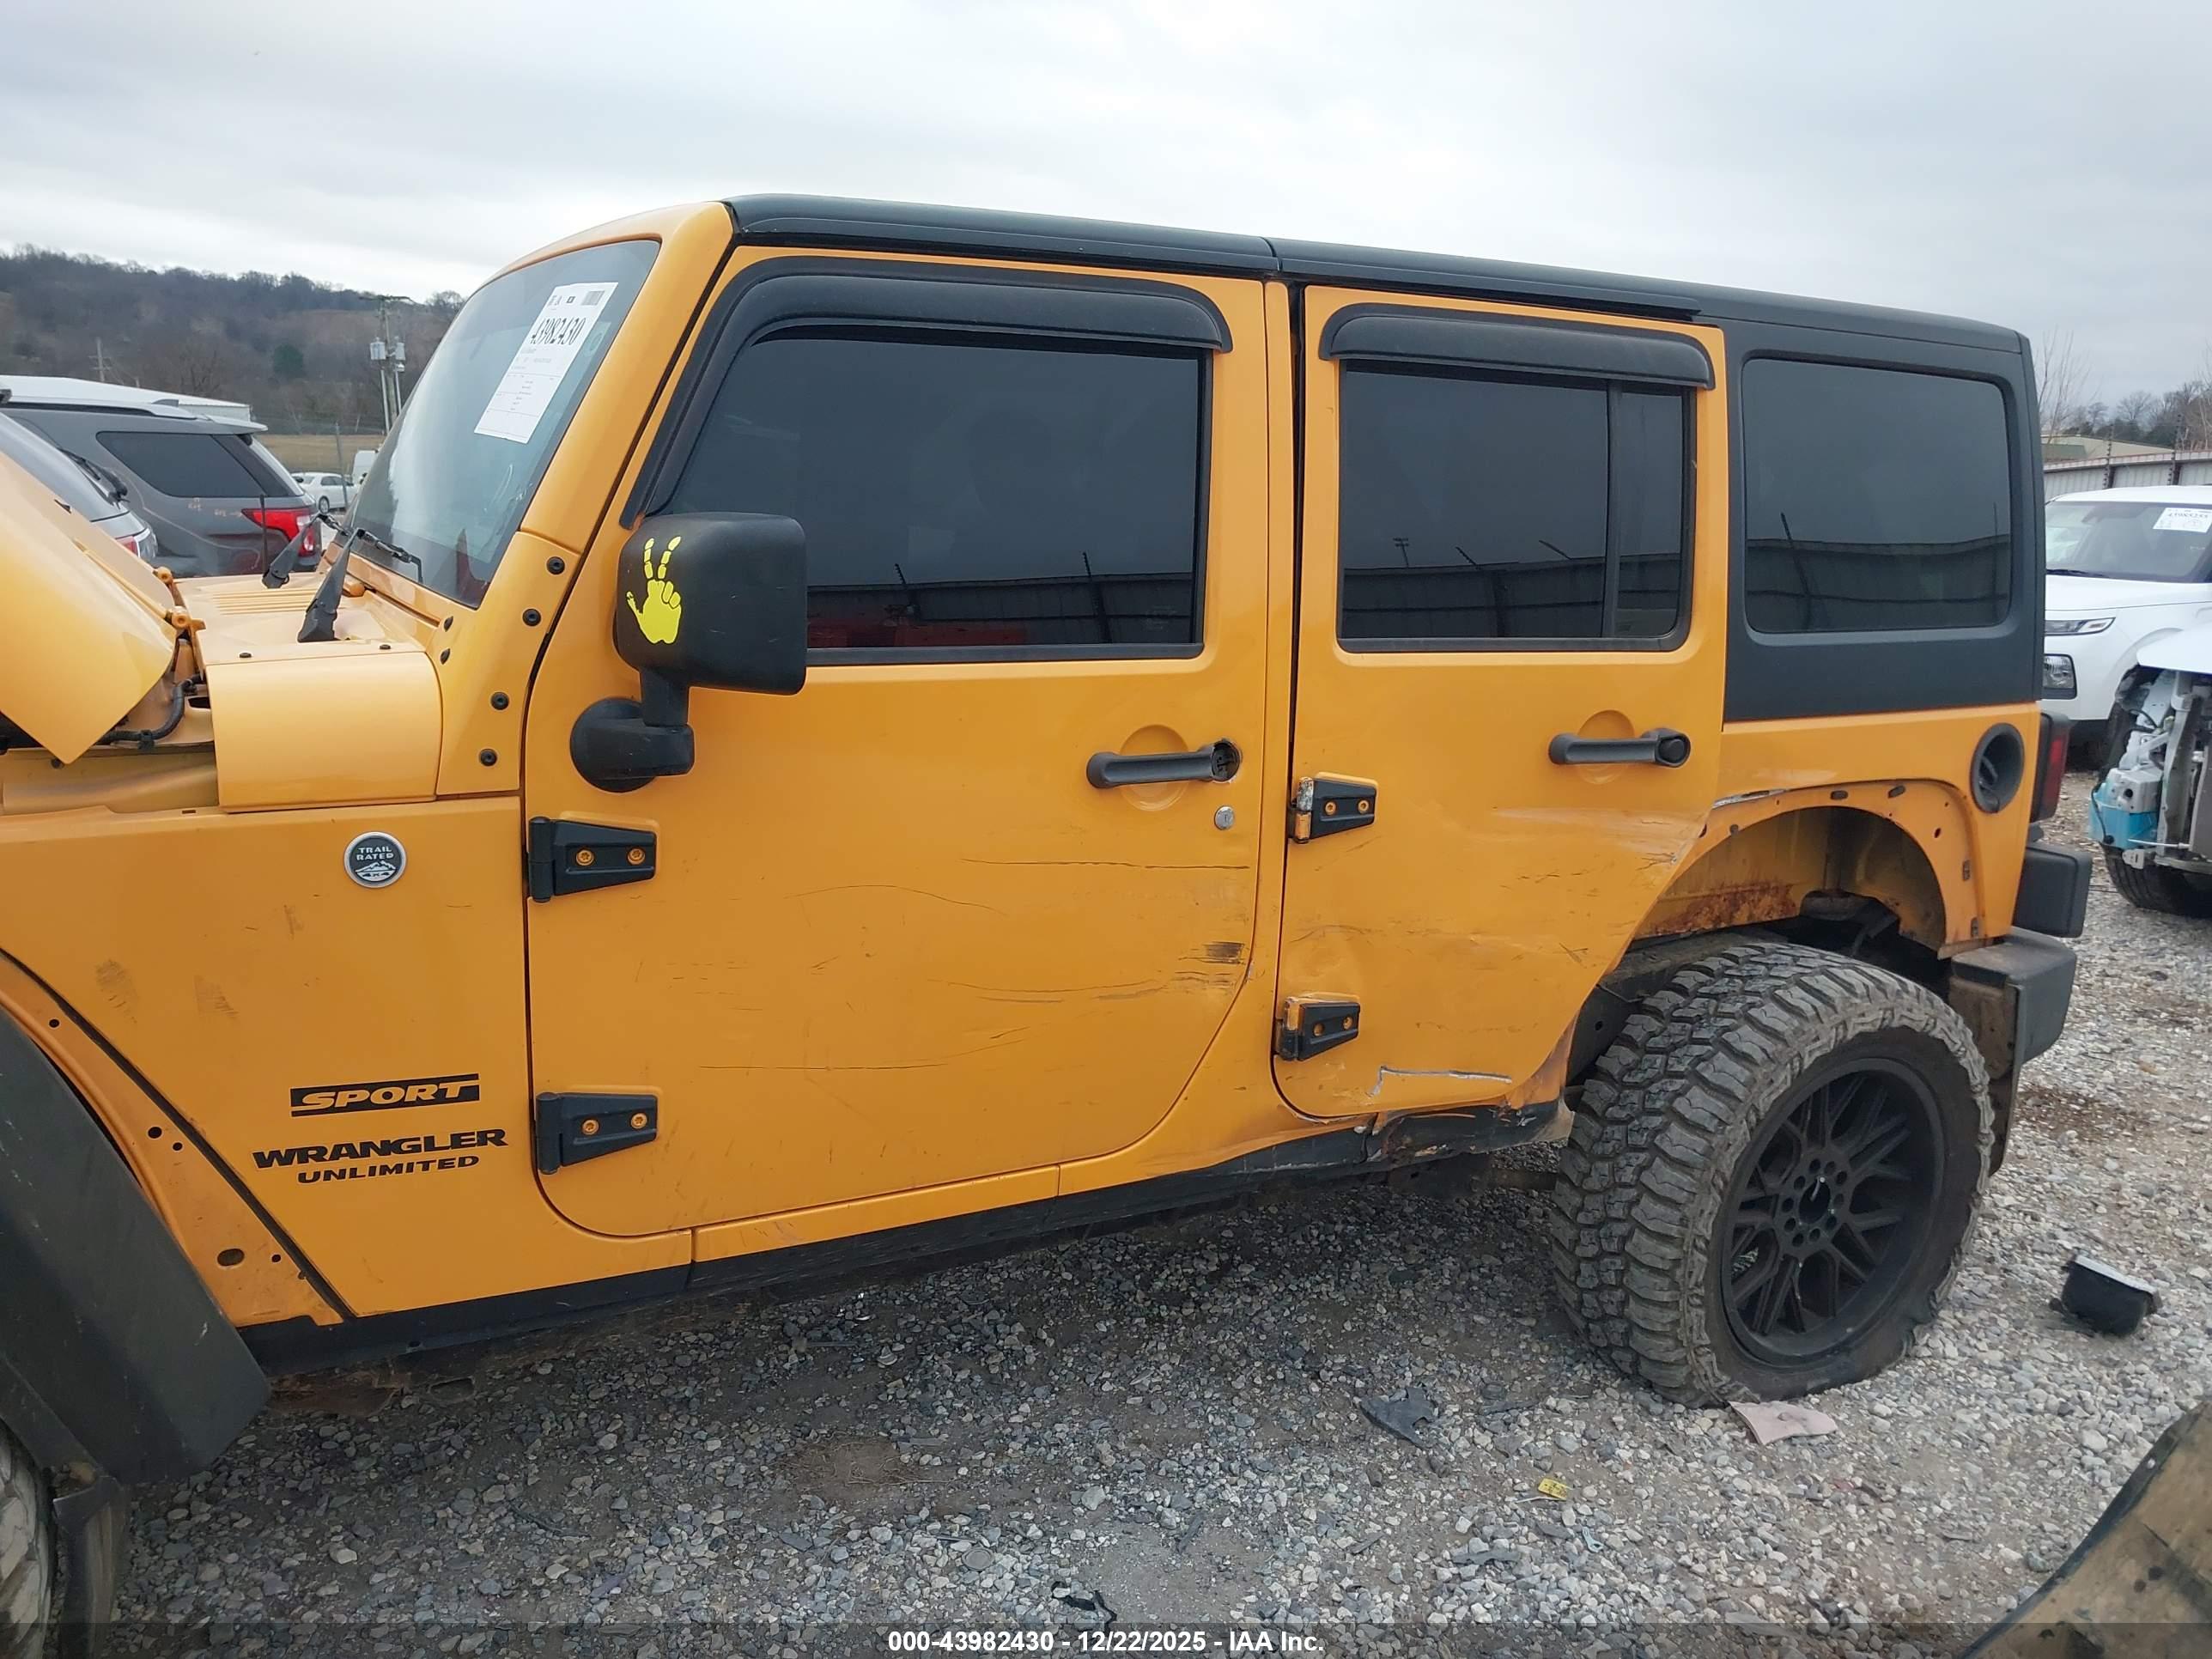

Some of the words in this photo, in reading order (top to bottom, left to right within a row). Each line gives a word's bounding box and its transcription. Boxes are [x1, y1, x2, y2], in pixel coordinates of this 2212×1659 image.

[530, 319, 586, 345] 43982430
[292, 1083, 479, 1109] SPORT
[252, 1129, 508, 1169] WRANGLER
[297, 1156, 480, 1184] UNLIMITED
